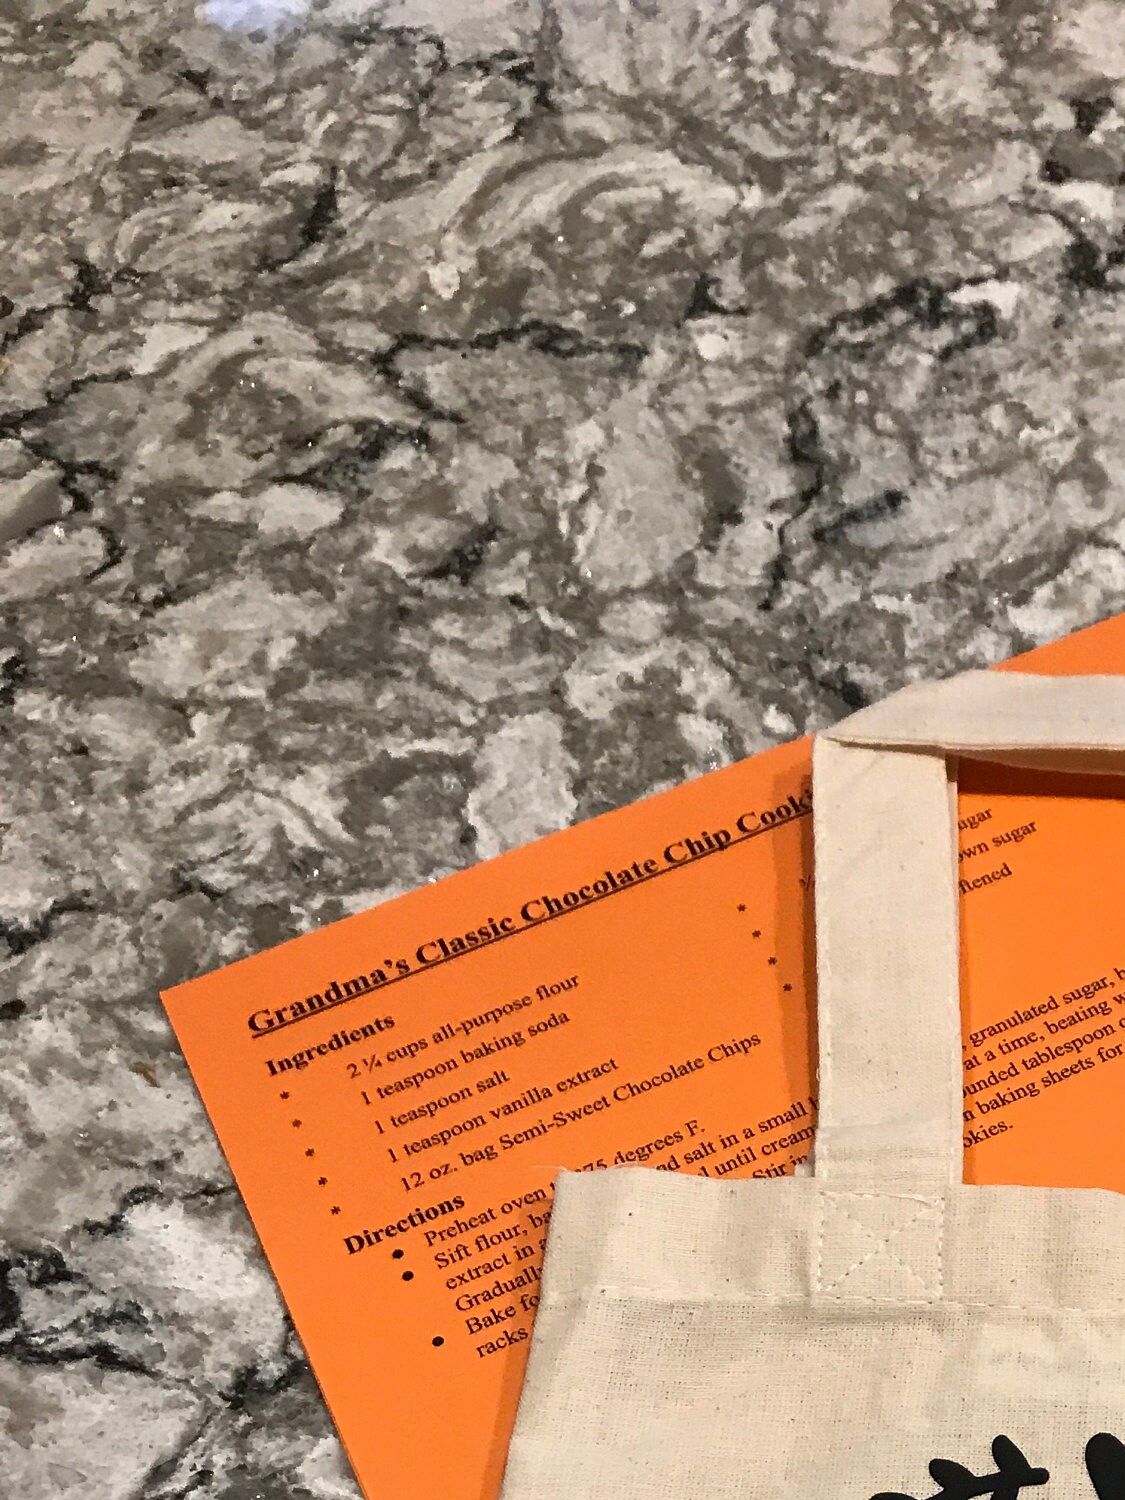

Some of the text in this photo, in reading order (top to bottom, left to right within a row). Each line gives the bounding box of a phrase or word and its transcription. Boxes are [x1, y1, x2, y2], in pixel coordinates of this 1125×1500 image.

[991, 821, 1037, 848] sugar
[415, 917, 519, 971] Classic
[519, 859, 662, 929] Chocolate
[663, 829, 735, 870] Chip
[265, 1016, 396, 1077] Ingredients
[346, 1063, 362, 1079] 2
[386, 1038, 429, 1063] cups
[432, 995, 533, 1045] all-purpose
[535, 975, 579, 1001] flour
[962, 1054, 983, 1071] at
[983, 1050, 997, 1062] a
[997, 1031, 1046, 1056] time,
[1043, 1000, 1113, 1035] beating
[969, 995, 1061, 1048] granulated
[1062, 976, 1116, 1005] sugar,
[1021, 1024, 1117, 1071] tablespoon
[361, 1012, 571, 1106] 1 teaspoon baking soda
[974, 1082, 1041, 1115] baking
[1040, 1057, 1096, 1088] sheets
[1096, 1043, 1124, 1063] for
[374, 1070, 511, 1135] 1 teaspoon salt
[387, 1058, 619, 1163] 1 teaspoon vanilla extract
[401, 1034, 762, 1192] 12 oz. bag Semi-Sweet Chocolate Chips
[423, 1207, 498, 1247] Preheat
[500, 1188, 547, 1215] oven
[614, 1130, 684, 1168] degrees
[684, 1119, 706, 1137] F.
[434, 1243, 473, 1270] Sift
[474, 1224, 528, 1253] flour,
[683, 1141, 717, 1165] salt
[718, 1134, 740, 1150] in
[742, 1127, 756, 1140] a
[757, 1101, 809, 1133] small
[445, 1252, 512, 1290] extract
[512, 1245, 535, 1261] in
[714, 1146, 757, 1176] until
[761, 1117, 817, 1156] cream
[343, 1195, 465, 1256] Directions
[465, 1305, 517, 1336] Bake
[476, 1327, 529, 1358] racks
